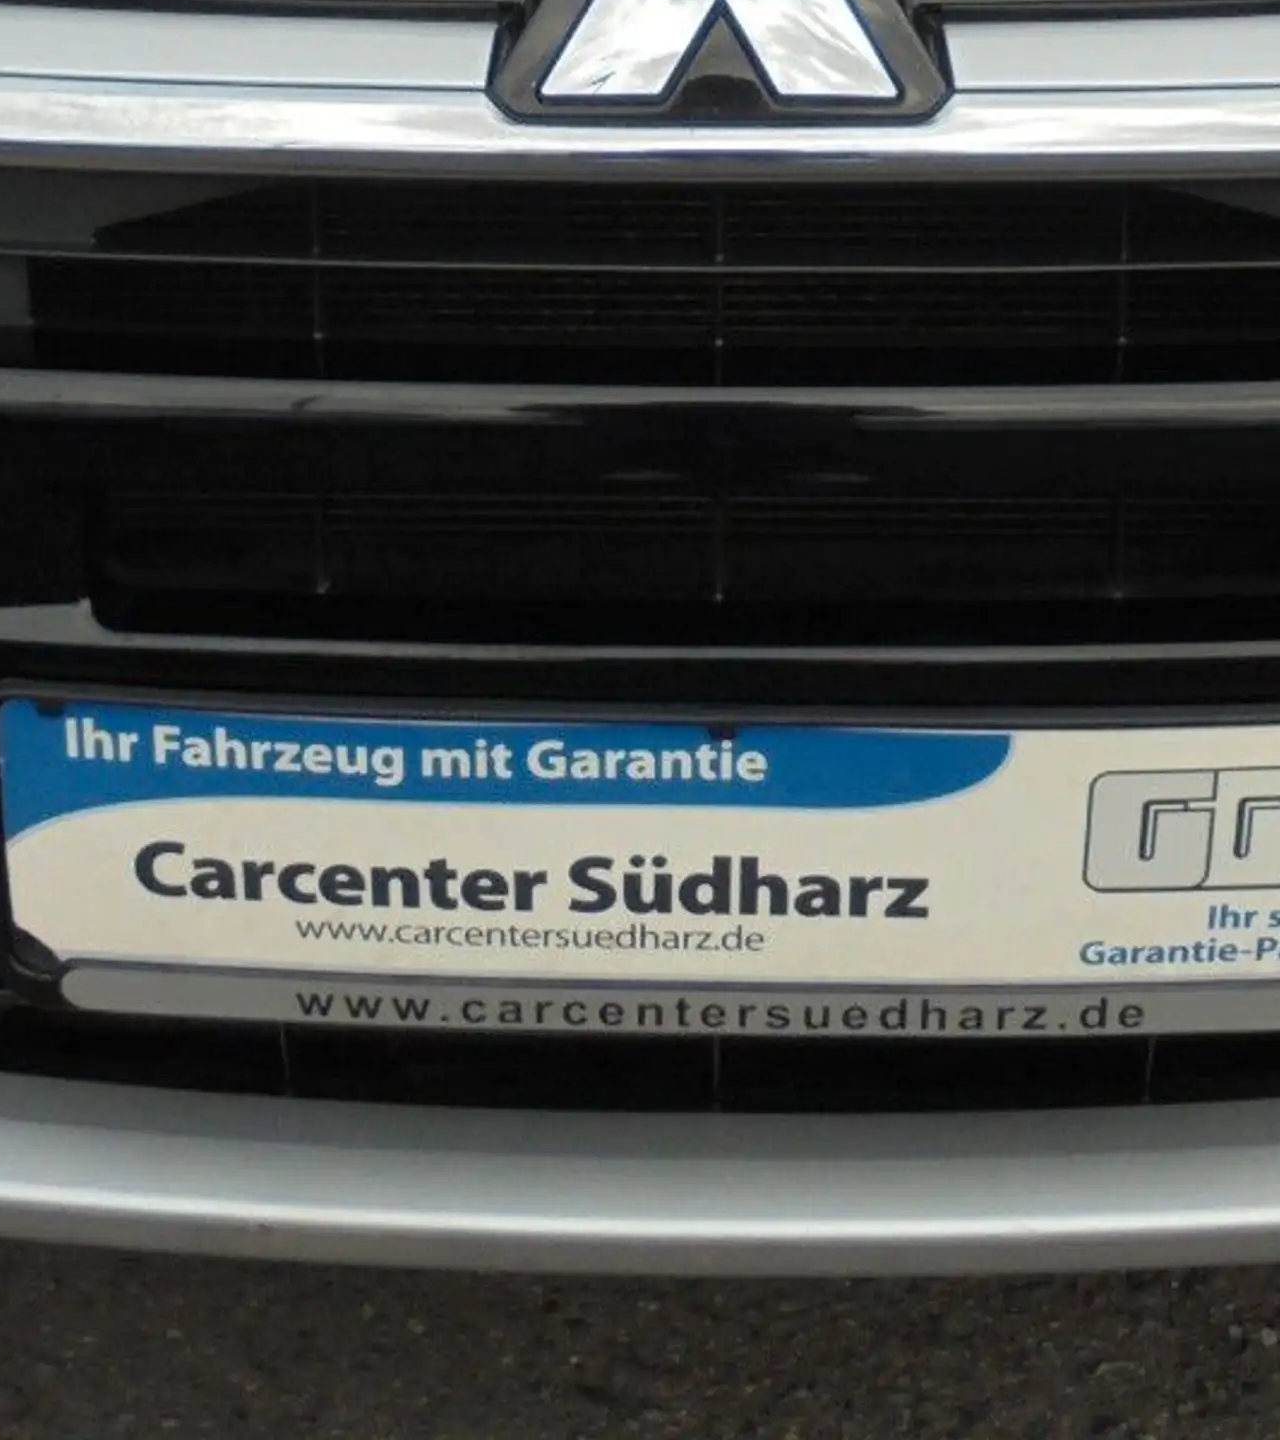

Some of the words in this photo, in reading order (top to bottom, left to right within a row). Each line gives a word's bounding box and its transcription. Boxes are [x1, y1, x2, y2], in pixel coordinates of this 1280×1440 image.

[65, 717, 137, 762] Ihr
[155, 725, 405, 786] Fahrzeug
[422, 740, 512, 779] mit
[527, 739, 769, 783] Garantie
[135, 841, 548, 912] Carcenter
[569, 855, 929, 918] Südharz
[296, 917, 765, 953] www.carcentersuedharz.de
[1208, 903, 1263, 930] Ihr
[296, 990, 1146, 1032] www.carcentersuedharz.de
